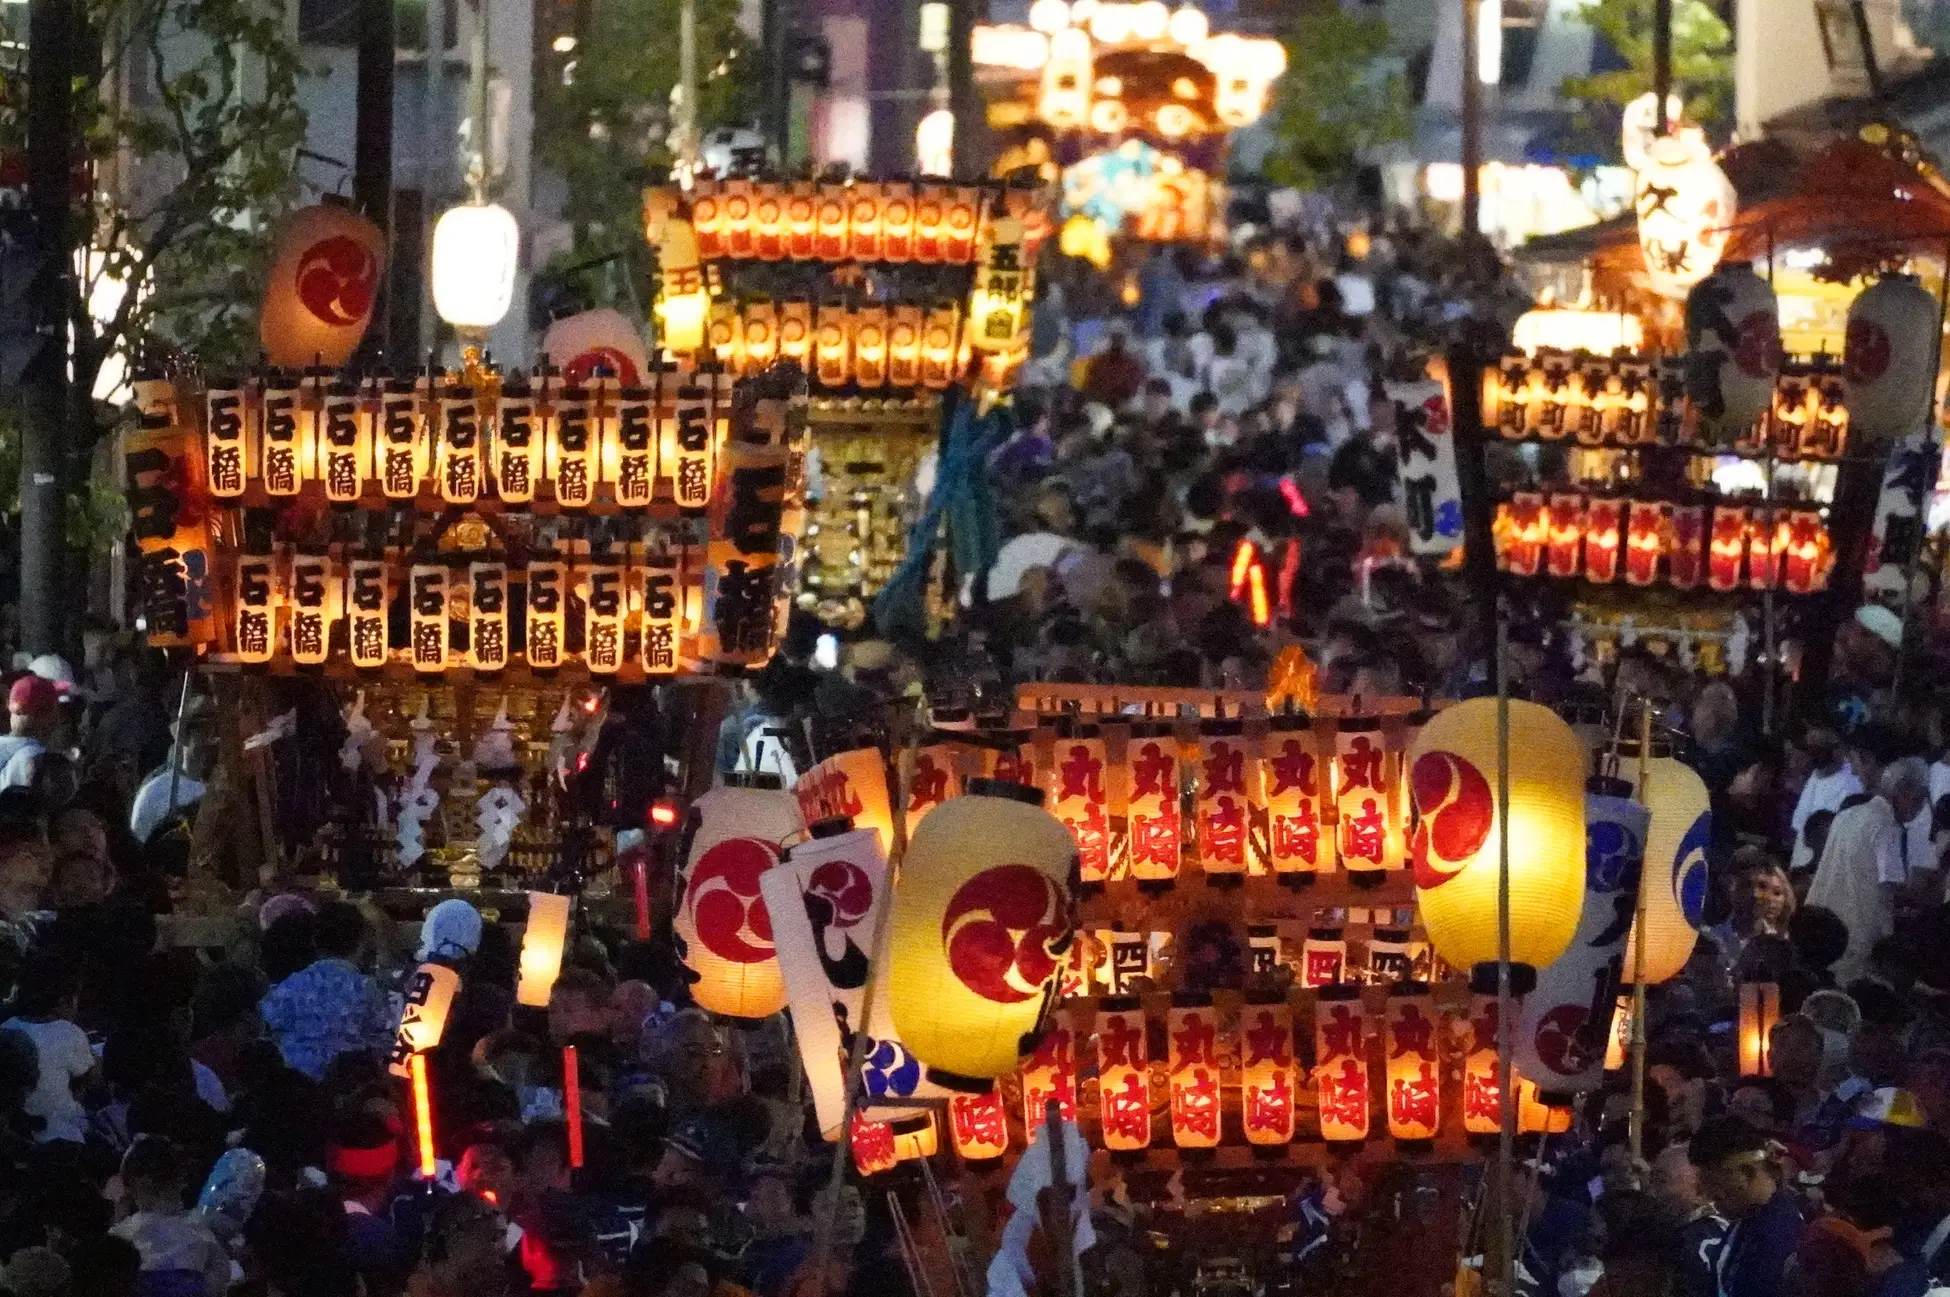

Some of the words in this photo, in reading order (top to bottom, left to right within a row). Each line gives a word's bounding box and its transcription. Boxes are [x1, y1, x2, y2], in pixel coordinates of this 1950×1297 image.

[209, 397, 241, 491] 石橋
[266, 397, 296, 491] 石橋
[326, 401, 358, 497] 石橋
[384, 397, 416, 494] 石橋
[446, 406, 478, 498] 石橋
[500, 405, 532, 496] 石橋
[558, 408, 589, 502] 石橋
[620, 405, 651, 500] 石橋
[678, 407, 710, 501] 石橋
[240, 565, 270, 654] 石橋
[294, 565, 324, 655] 石橋
[353, 568, 383, 660] 石橋
[414, 574, 444, 665] 石橋
[473, 571, 505, 665] 石橋
[529, 571, 560, 664] 石橋
[589, 574, 621, 667] 石橋
[645, 576, 675, 667] 石橋
[908, 753, 950, 813] 丸
[955, 1095, 1006, 1145] 崎
